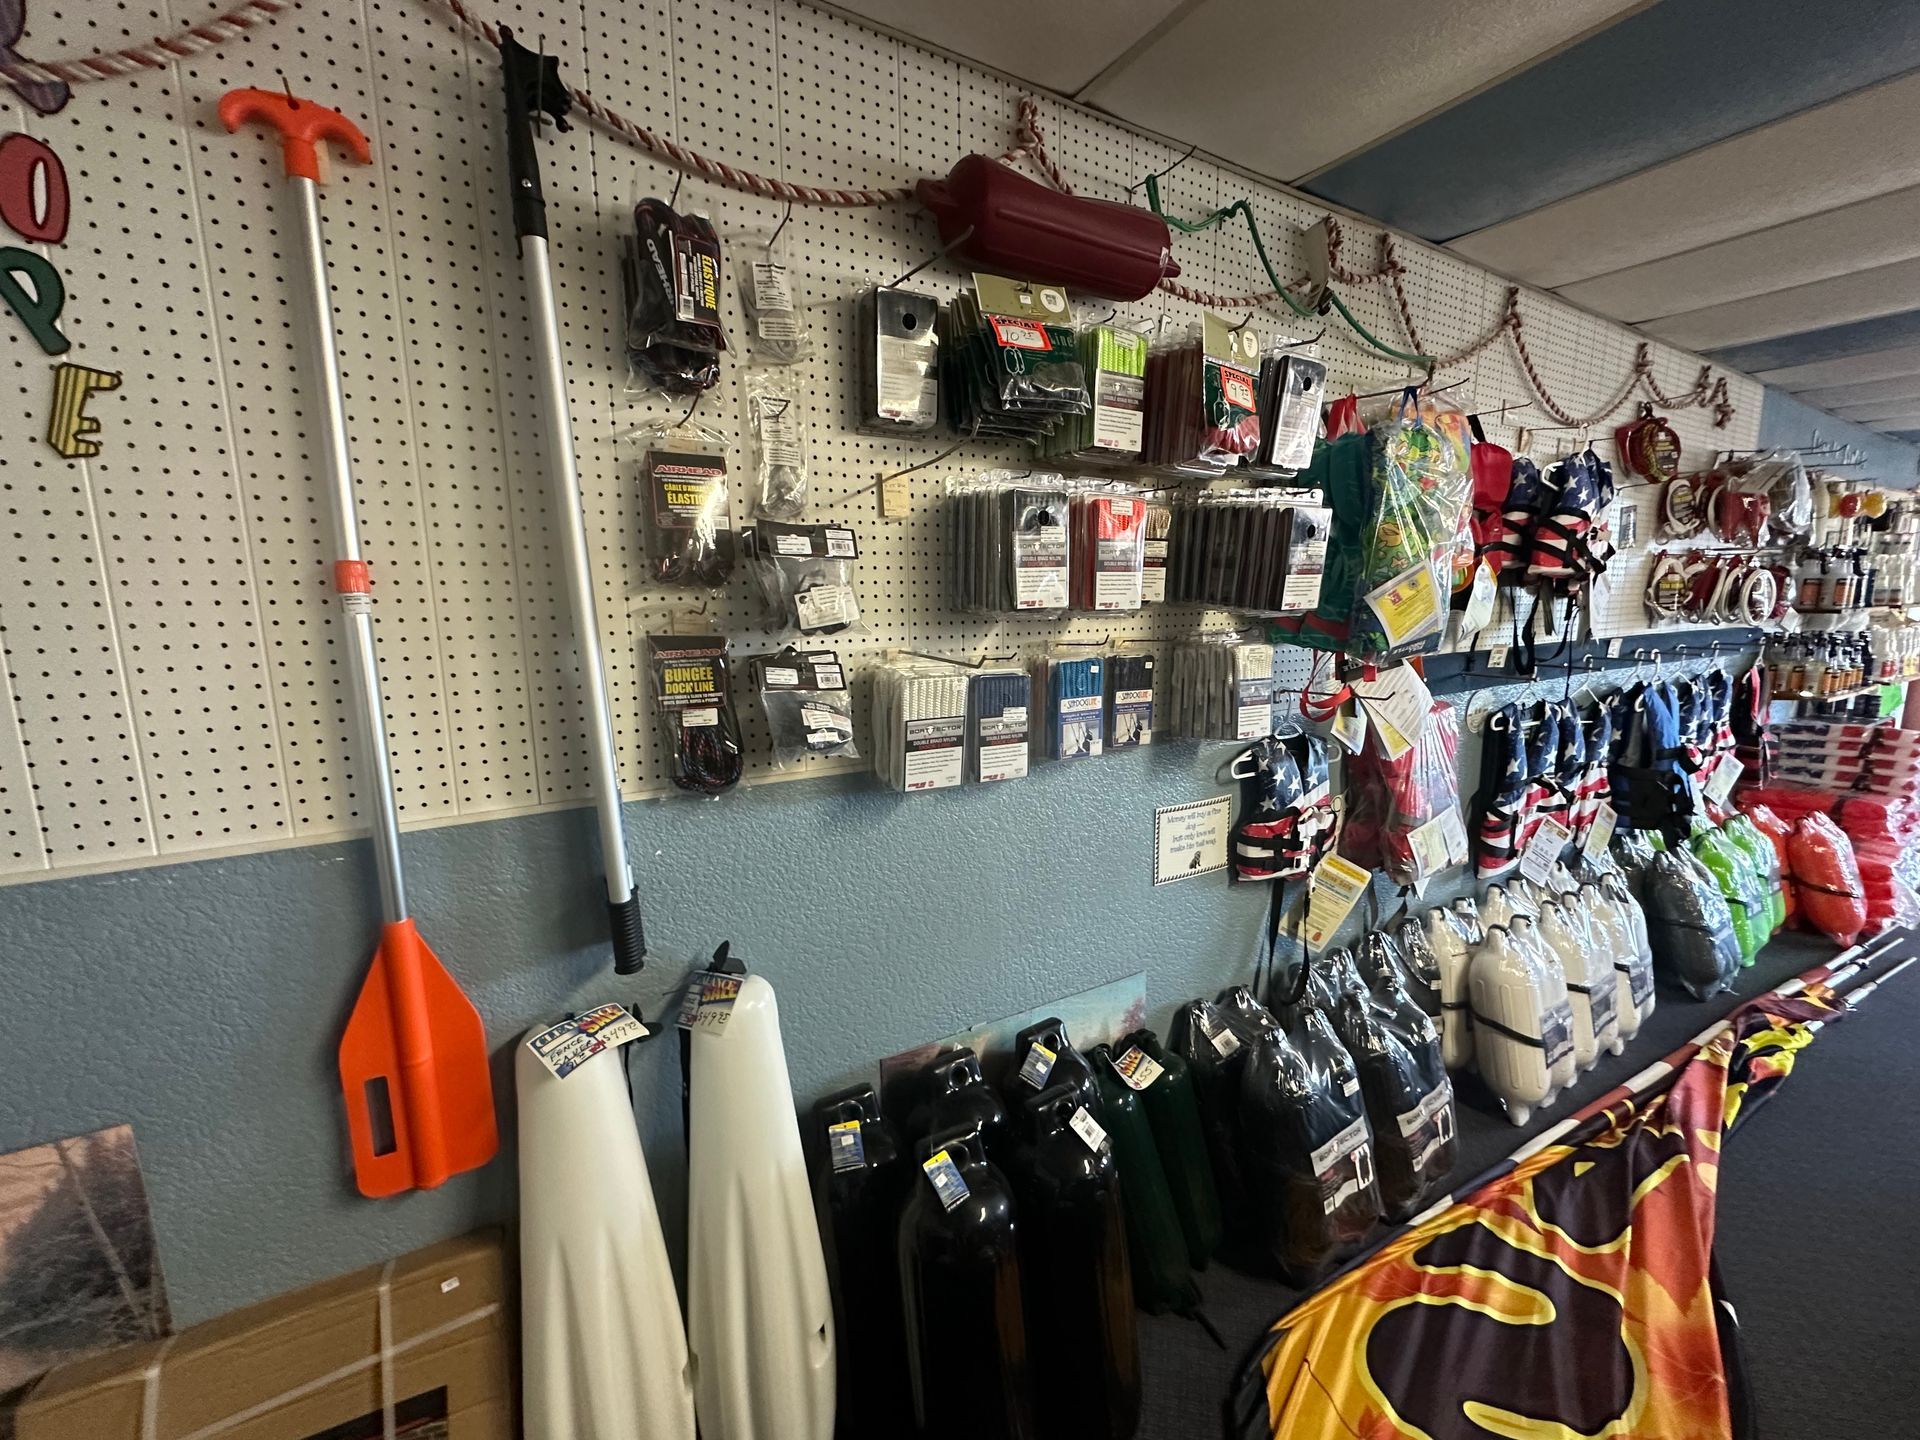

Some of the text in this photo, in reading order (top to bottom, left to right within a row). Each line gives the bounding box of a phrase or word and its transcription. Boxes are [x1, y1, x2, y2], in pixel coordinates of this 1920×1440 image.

[994, 318, 1038, 329] SPECIAL
[1224, 370, 1251, 387] SPECIAL
[654, 464, 722, 477] AIRHEAD
[654, 648, 721, 658] AIRHEAD
[664, 667, 714, 683] BUNGEE
[665, 681, 715, 694] DOCK LINE
